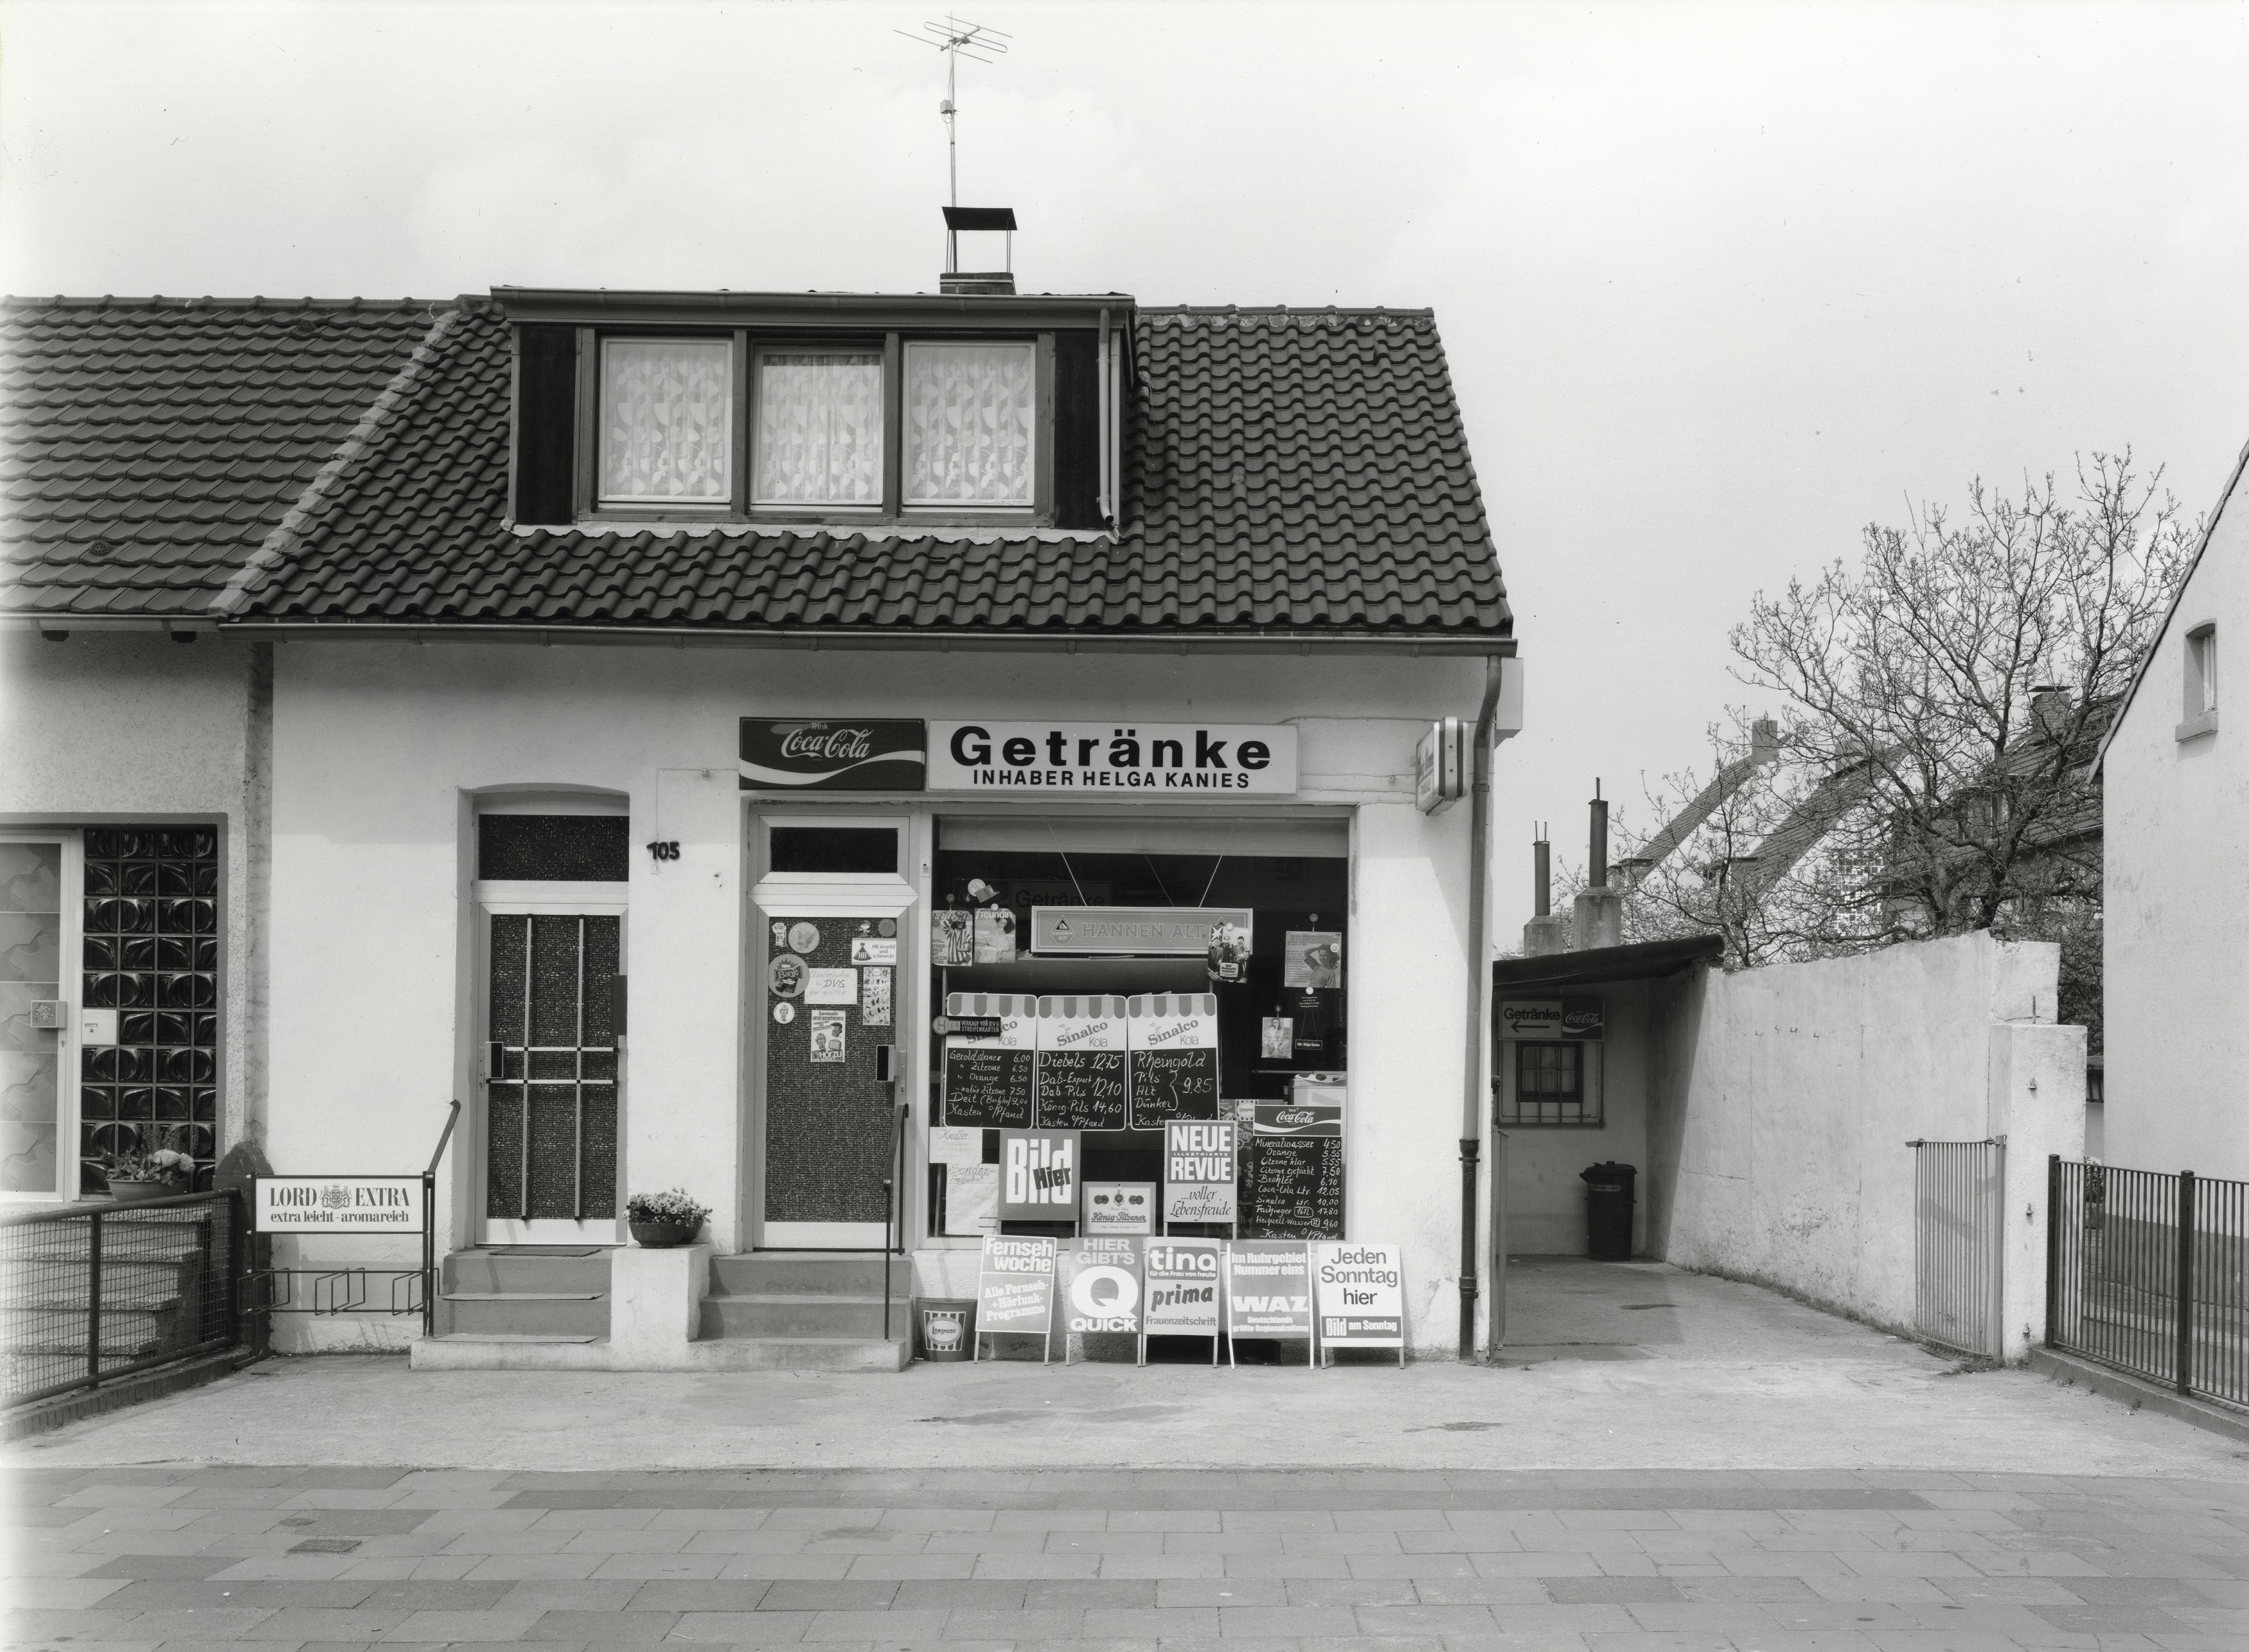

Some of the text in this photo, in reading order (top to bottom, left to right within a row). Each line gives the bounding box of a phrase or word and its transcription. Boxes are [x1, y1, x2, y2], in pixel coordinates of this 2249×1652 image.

[781, 729, 874, 758] Coca-Cola
[950, 725, 1270, 770] Getränke
[974, 770, 1249, 788] INHABER HELGA KANIES
[646, 841, 680, 860] 105
[976, 909, 1013, 919] freundin
[1081, 923, 1205, 939] HANNEN ALT
[778, 969, 799, 979] Banjo
[822, 979, 845, 988] DVG
[1504, 1008, 1560, 1020] Getränke
[1565, 1013, 1599, 1024] Coca-Cola
[938, 1019, 959, 1031] HIER
[1057, 1022, 1108, 1047] Sinalco
[1148, 1020, 1198, 1046] Sinalco
[998, 1036, 1017, 1045] Kola
[1089, 1037, 1108, 1047] Kola
[1180, 1035, 1198, 1045] Kola
[1013, 1052, 1031, 1063] 6.00
[1038, 1052, 1085, 1069] Diebels
[1134, 1051, 1205, 1076] Rheingold
[971, 1061, 1001, 1071] Zitrone
[969, 1072, 1027, 1085] Orange 6.50
[1040, 1071, 1092, 1086] Dab-Export
[1133, 1071, 1160, 1083] Pils
[981, 1085, 1006, 1094] Zitrone
[1041, 1085, 1086, 1097] Dab Pils
[1136, 1085, 1156, 1096] Alt
[1182, 1078, 1213, 1094] 9.85
[947, 1092, 977, 1103] Deit
[947, 1102, 982, 1117] Kasten
[1038, 1099, 1122, 1115] König-Pils 14,60
[1040, 1116, 1069, 1127] Kasten
[1135, 1114, 1165, 1126] Kaste
[1276, 1110, 1316, 1124] Coca-Cola
[937, 1129, 968, 1140] Knaller
[1171, 1126, 1231, 1151] NEUE
[1255, 1137, 1341, 1149] Mineralwasser 4.50
[1267, 1148, 1341, 1158] Orange 5.55
[1261, 1157, 1340, 1166] Citrone klar 5.55
[948, 1164, 995, 1175] Sonder-
[1006, 1139, 1072, 1204] Bild
[1171, 1157, 1231, 1181] REVUE
[1287, 1166, 1315, 1177] gefärbt
[1322, 1167, 1340, 1177] 7.50
[950, 1175, 984, 1186] Angebot
[1033, 1166, 1071, 1190] Hier
[1258, 1174, 1337, 1187] Brohler 6.10
[1258, 1185, 1294, 1194] Coca-Cola
[1317, 1186, 1340, 1196] 12.05
[269, 1187, 411, 1207] LORD EXTRA
[1256, 1195, 1286, 1204] Sinalco
[1317, 1196, 1338, 1205] 10.00
[271, 1211, 409, 1222] extra leicht aromareich
[1169, 1200, 1231, 1221] Lebensfreude
[1317, 1207, 1338, 1216] 17.80
[1091, 1211, 1146, 1223] König-Pilsener
[1259, 1228, 1297, 1239] Kasten
[985, 1237, 1053, 1257] Fernseh
[1083, 1239, 1130, 1251] HIER
[1075, 1252, 1135, 1265] GIBT'S
[1150, 1247, 1217, 1272] tina
[1231, 1253, 1307, 1265] Im Ruhrgebiet
[1331, 1247, 1387, 1265] Jeden
[993, 1256, 1051, 1272] woche
[1234, 1265, 1305, 1275] Nummer eins
[1321, 1265, 1398, 1287] Sonntag
[984, 1280, 1049, 1299] Alle Fernseh-
[1071, 1265, 1139, 1319] Q
[1151, 1284, 1213, 1311] prima
[1344, 1288, 1378, 1305] hier
[1232, 1296, 1309, 1312] WAZ
[985, 1305, 1046, 1322] Programme
[1070, 1318, 1138, 1332] QUICK
[1146, 1316, 1217, 1326] Frauenzeitschrift
[932, 1326, 956, 1335] Langnese
[1255, 1324, 1309, 1333] Regionalzeitung
[1326, 1318, 1398, 1337] Bild am Sonntag
